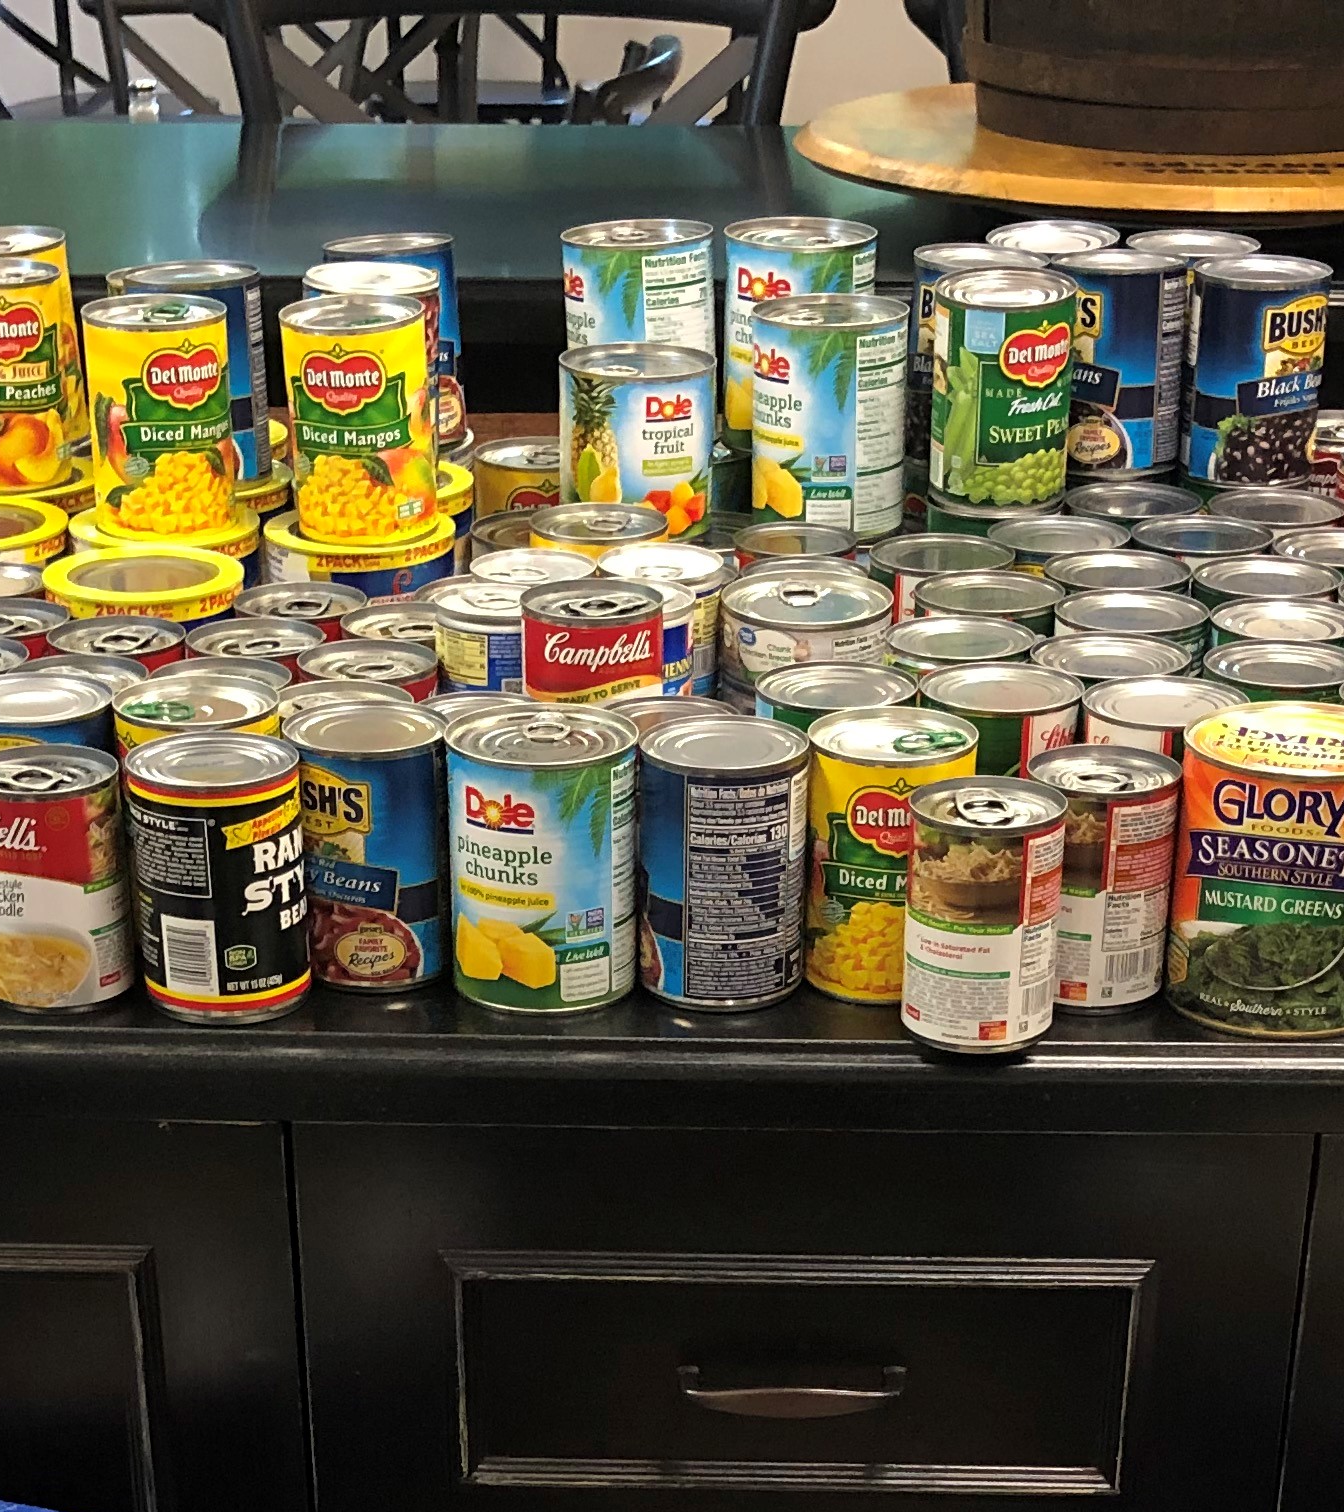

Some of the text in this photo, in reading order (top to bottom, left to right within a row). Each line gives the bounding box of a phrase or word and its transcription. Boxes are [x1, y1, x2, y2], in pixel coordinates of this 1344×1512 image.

[736, 266, 792, 299] Dole
[1007, 345, 1034, 366] Del
[150, 361, 219, 385] Del Monte
[306, 367, 380, 387] Del Monte
[5, 382, 57, 400] Peaches
[1256, 375, 1301, 399] Black
[645, 394, 692, 421] Dole
[140, 424, 184, 443] Diced
[303, 426, 401, 449] Diced Mangos
[642, 423, 694, 443] tropical
[988, 422, 1044, 445] SWEET
[653, 440, 685, 455] fruit
[545, 630, 652, 673] Campbell's
[593, 688, 609, 700] TO
[611, 679, 641, 694] SERVE
[464, 785, 535, 833] Dole
[855, 804, 889, 827] Del
[770, 823, 788, 840] 130
[458, 835, 553, 866] pineapple
[322, 868, 382, 894] Beans
[466, 858, 539, 887] chunks
[838, 869, 887, 890] Diced
[1217, 861, 1334, 886] SOUTHERN STYLE
[1204, 889, 1277, 916] MUSTARD
[348, 951, 396, 967] Recipes
